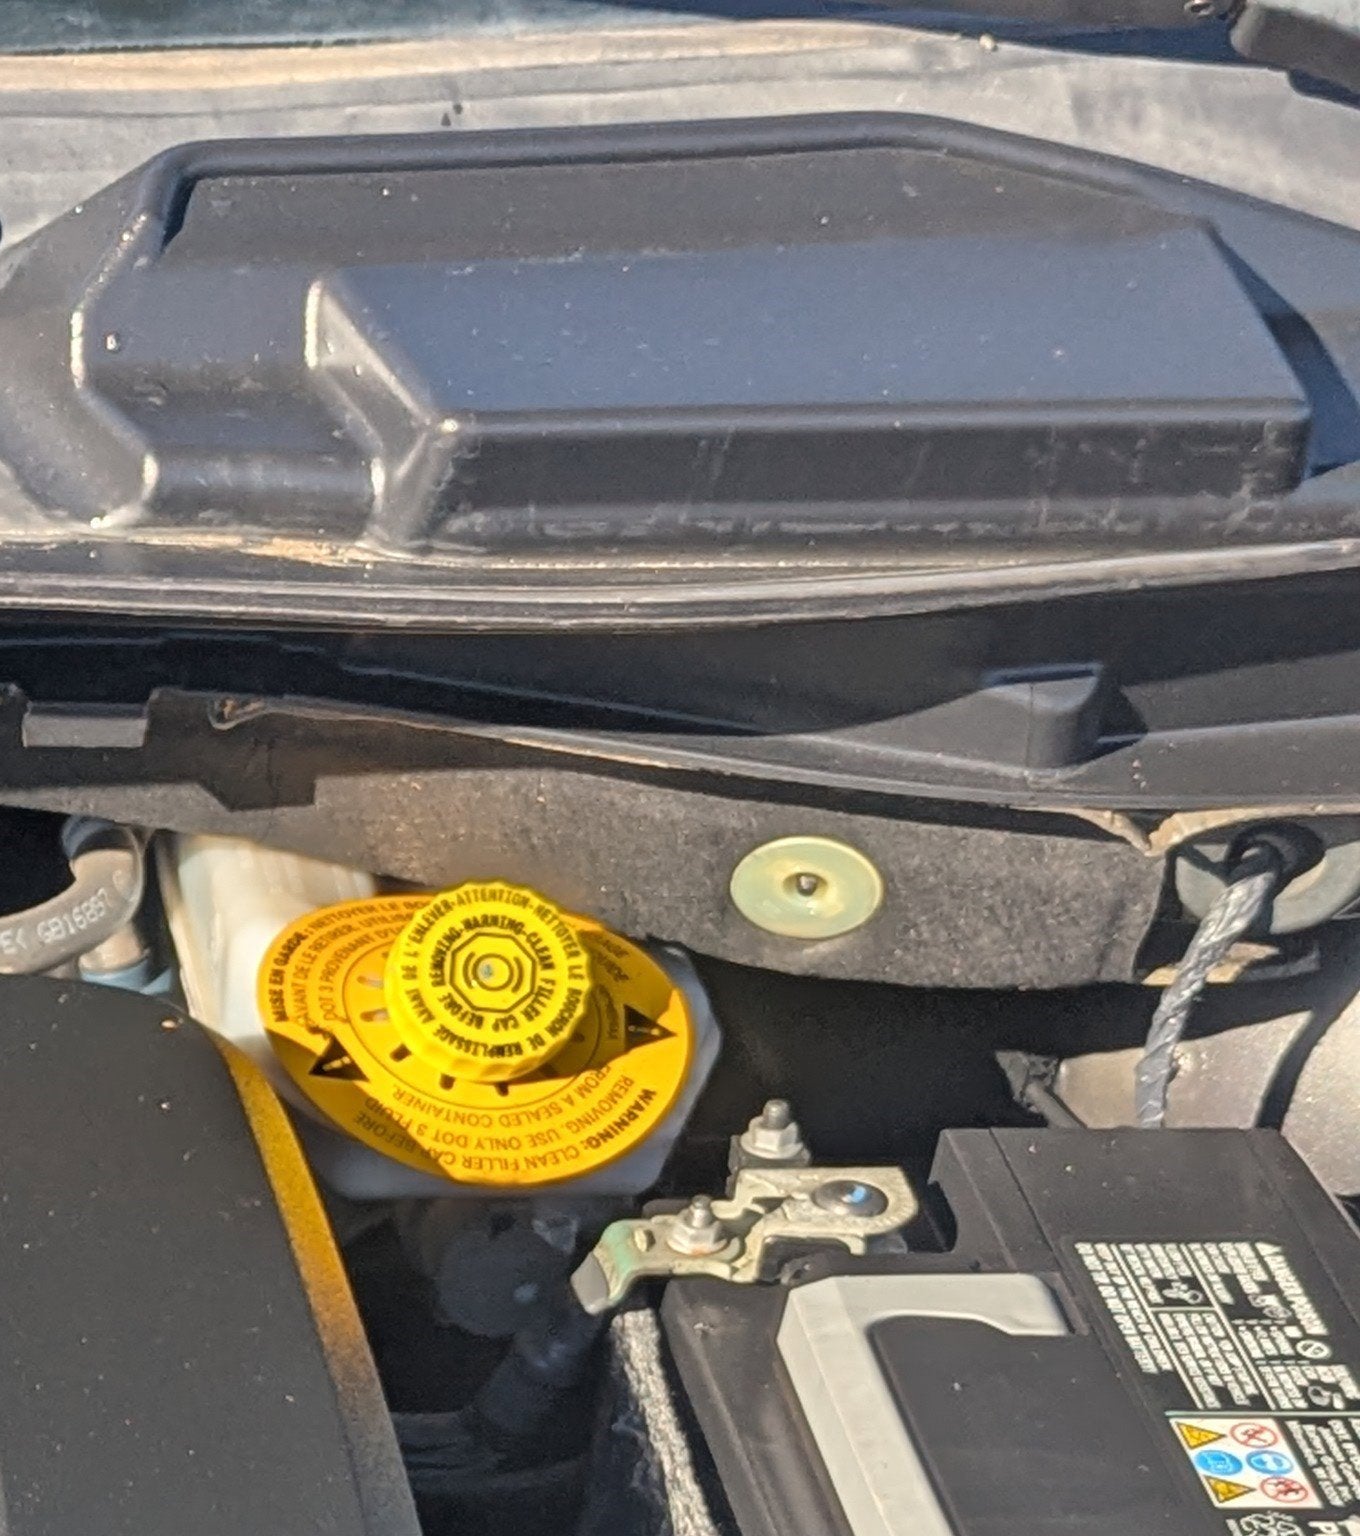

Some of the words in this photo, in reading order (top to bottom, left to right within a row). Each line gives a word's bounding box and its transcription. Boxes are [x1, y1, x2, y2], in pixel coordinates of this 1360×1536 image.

[561, 1094, 575, 1107] A
[498, 1102, 563, 1128] SEALED
[355, 1111, 416, 1153] BEFORE
[416, 1122, 429, 1137] 3
[525, 1128, 561, 1148] USE
[433, 1130, 469, 1148] DOT
[474, 1136, 523, 1151] ONLY
[462, 1155, 520, 1171] FILLER
[525, 1145, 580, 1169] CLEAN
